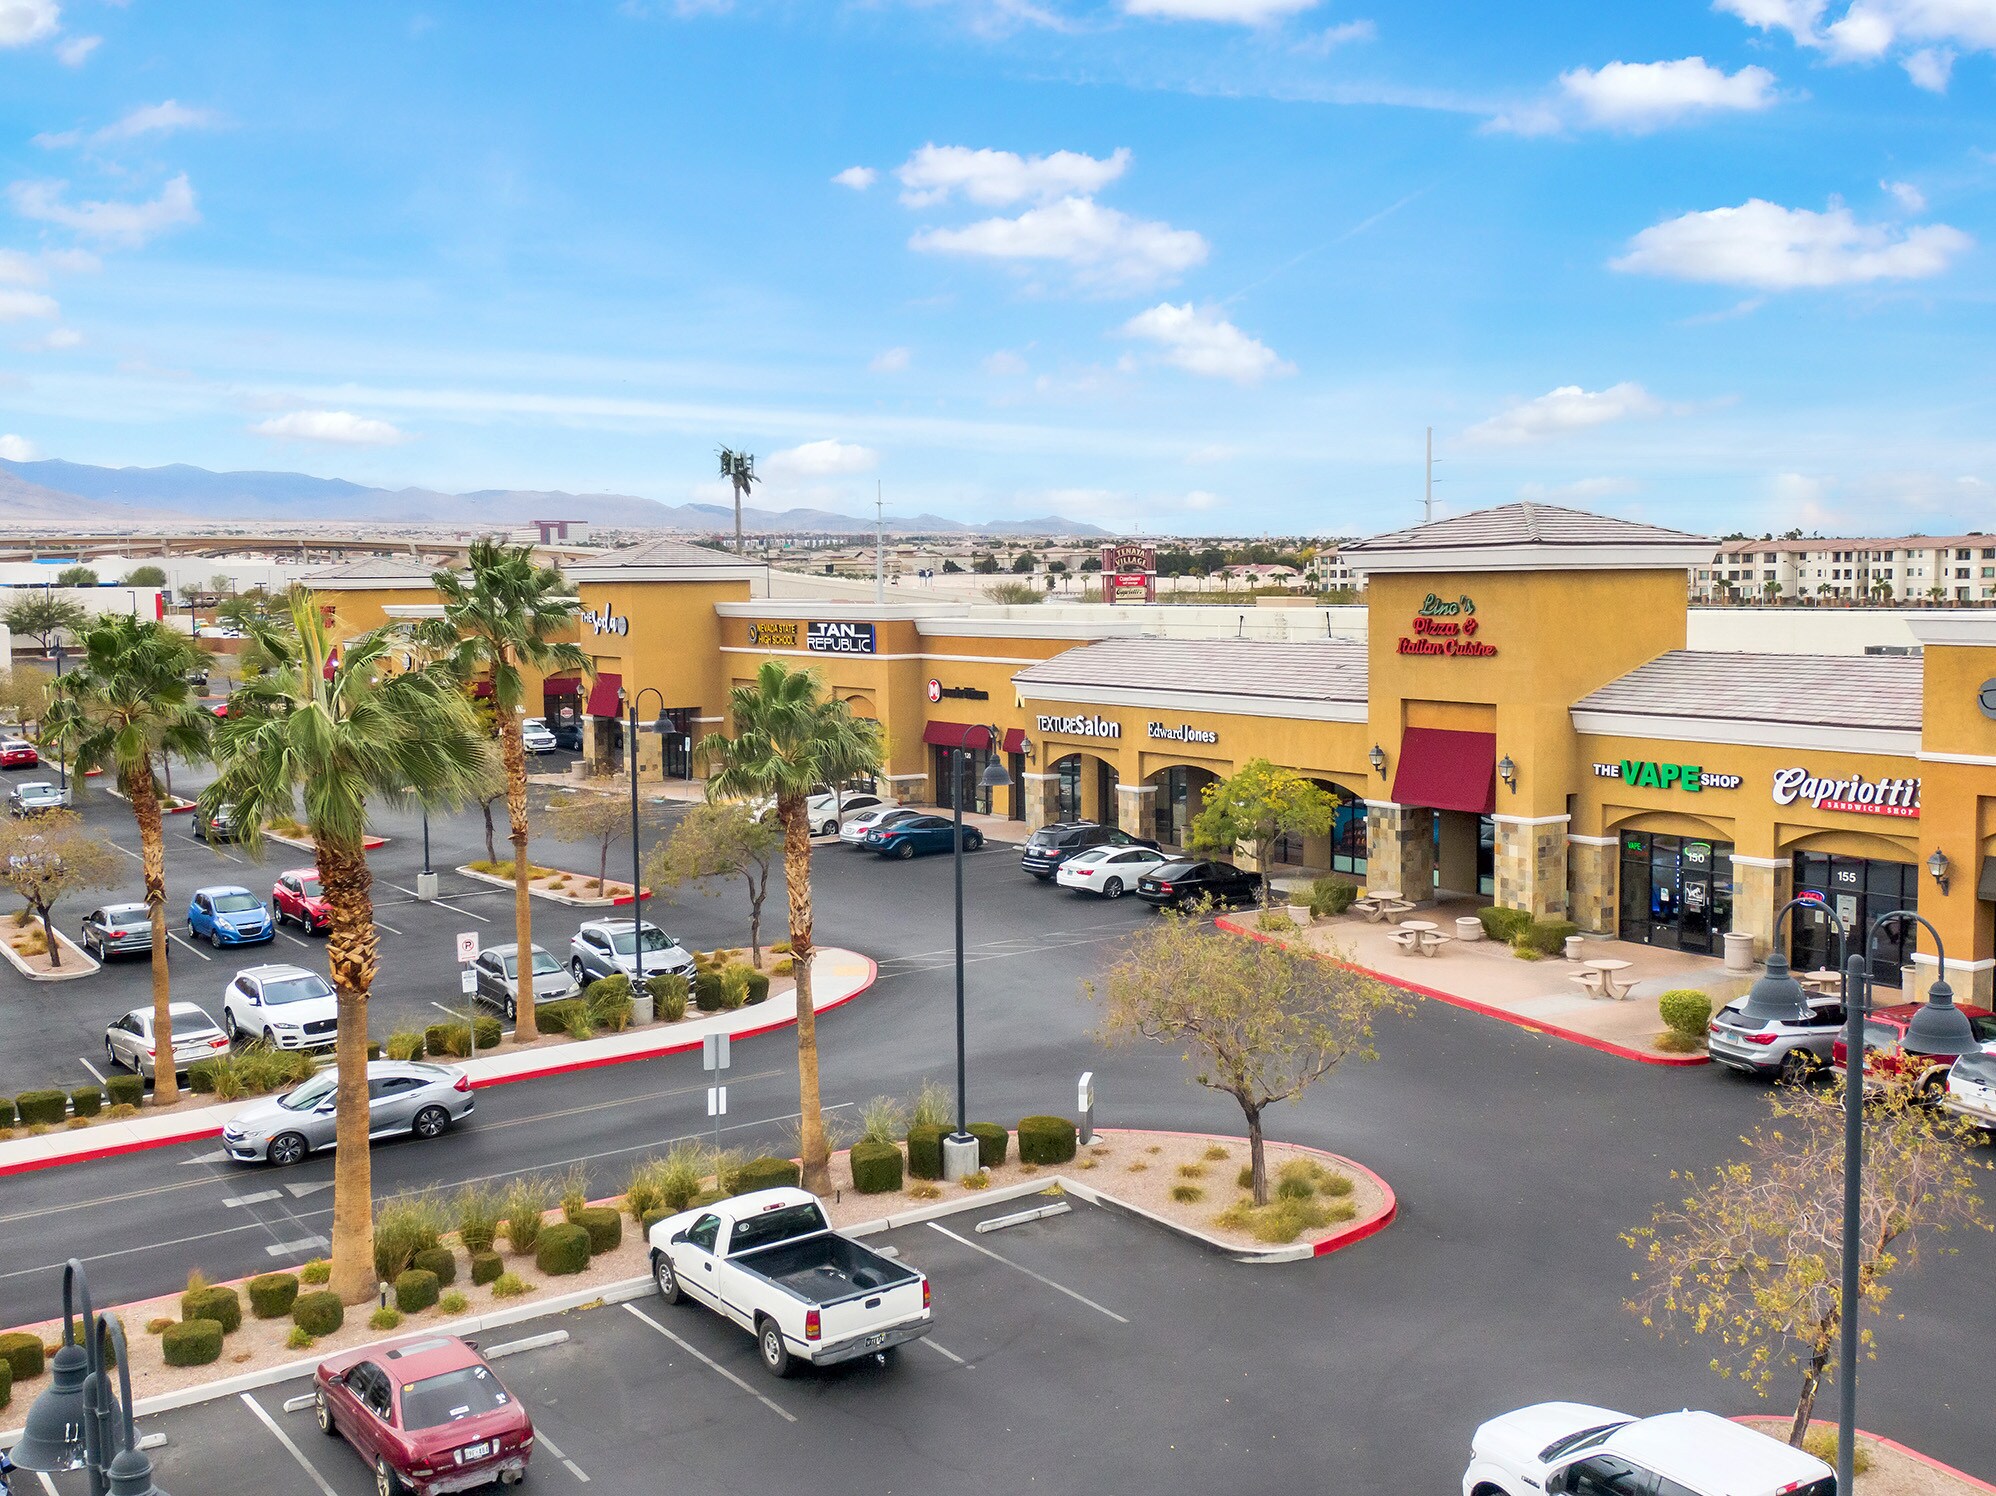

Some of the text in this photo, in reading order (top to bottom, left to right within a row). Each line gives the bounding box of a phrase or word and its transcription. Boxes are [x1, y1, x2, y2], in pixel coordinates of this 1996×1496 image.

[1115, 557, 1147, 566] VILLAGE
[1418, 592, 1475, 615] Lino's
[757, 624, 796, 634] NEVADA STATE
[814, 623, 858, 637] TAN
[1413, 617, 1478, 636] Pizza &
[758, 635, 796, 645] HIGH SCHOOL
[807, 638, 870, 652] REPUBLIC
[1396, 637, 1497, 656] Italian Cuisine
[1593, 760, 1741, 792] THE VAPE SHOP
[1827, 802, 1914, 815] SANDWICH SHOP
[1689, 853, 1704, 863] 150
[1838, 871, 1856, 882] 155
